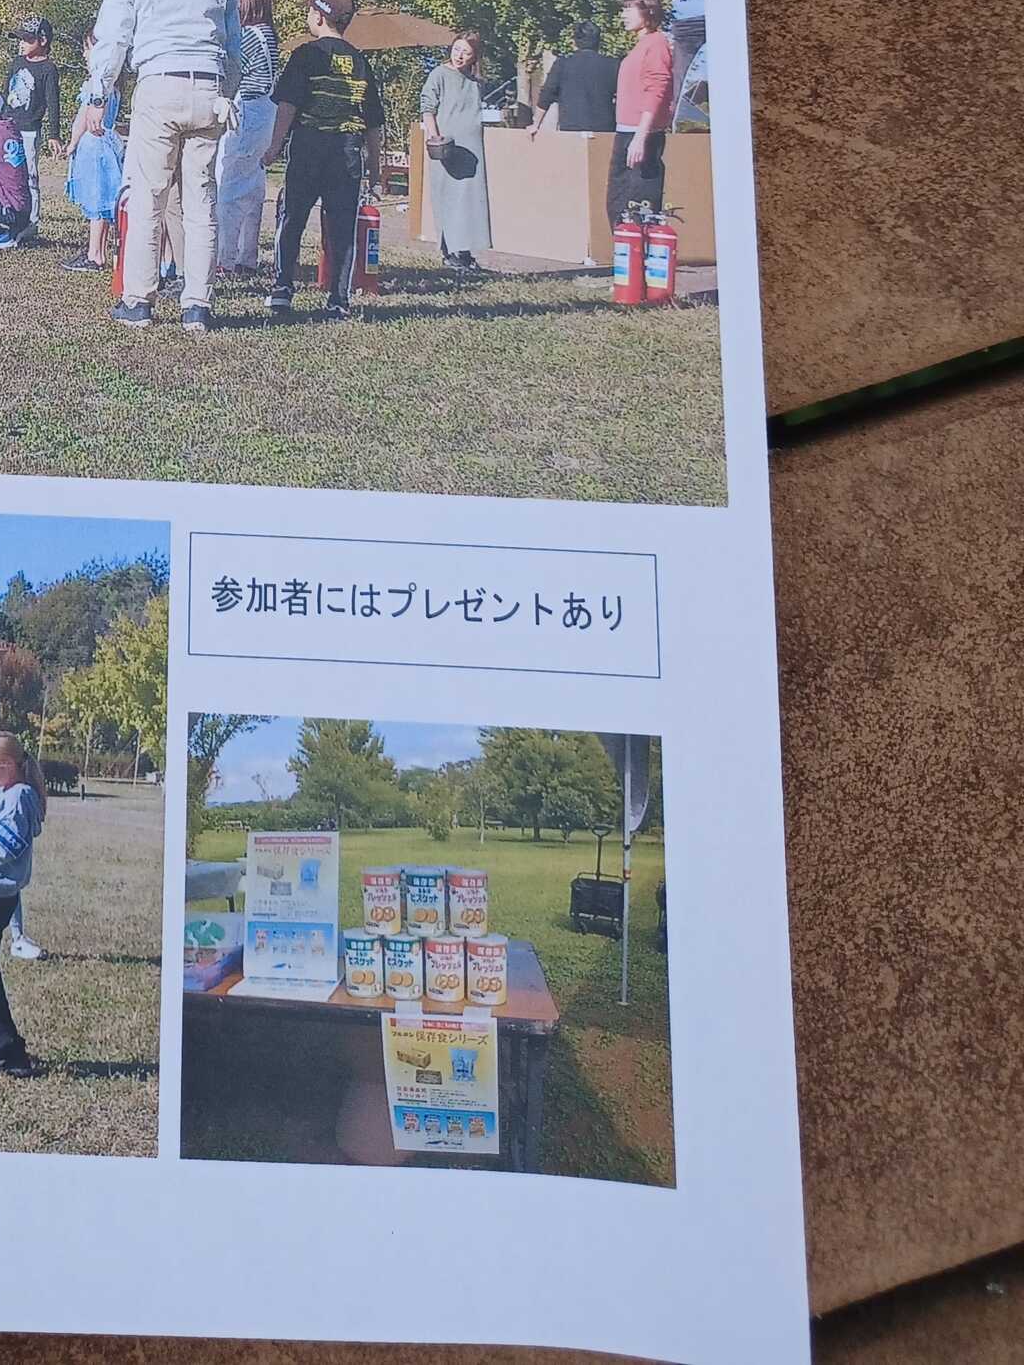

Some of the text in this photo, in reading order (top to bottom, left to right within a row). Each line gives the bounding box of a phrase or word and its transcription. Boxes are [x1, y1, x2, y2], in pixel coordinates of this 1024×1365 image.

[211, 575, 623, 631] 参加者にはプレゼントあり
